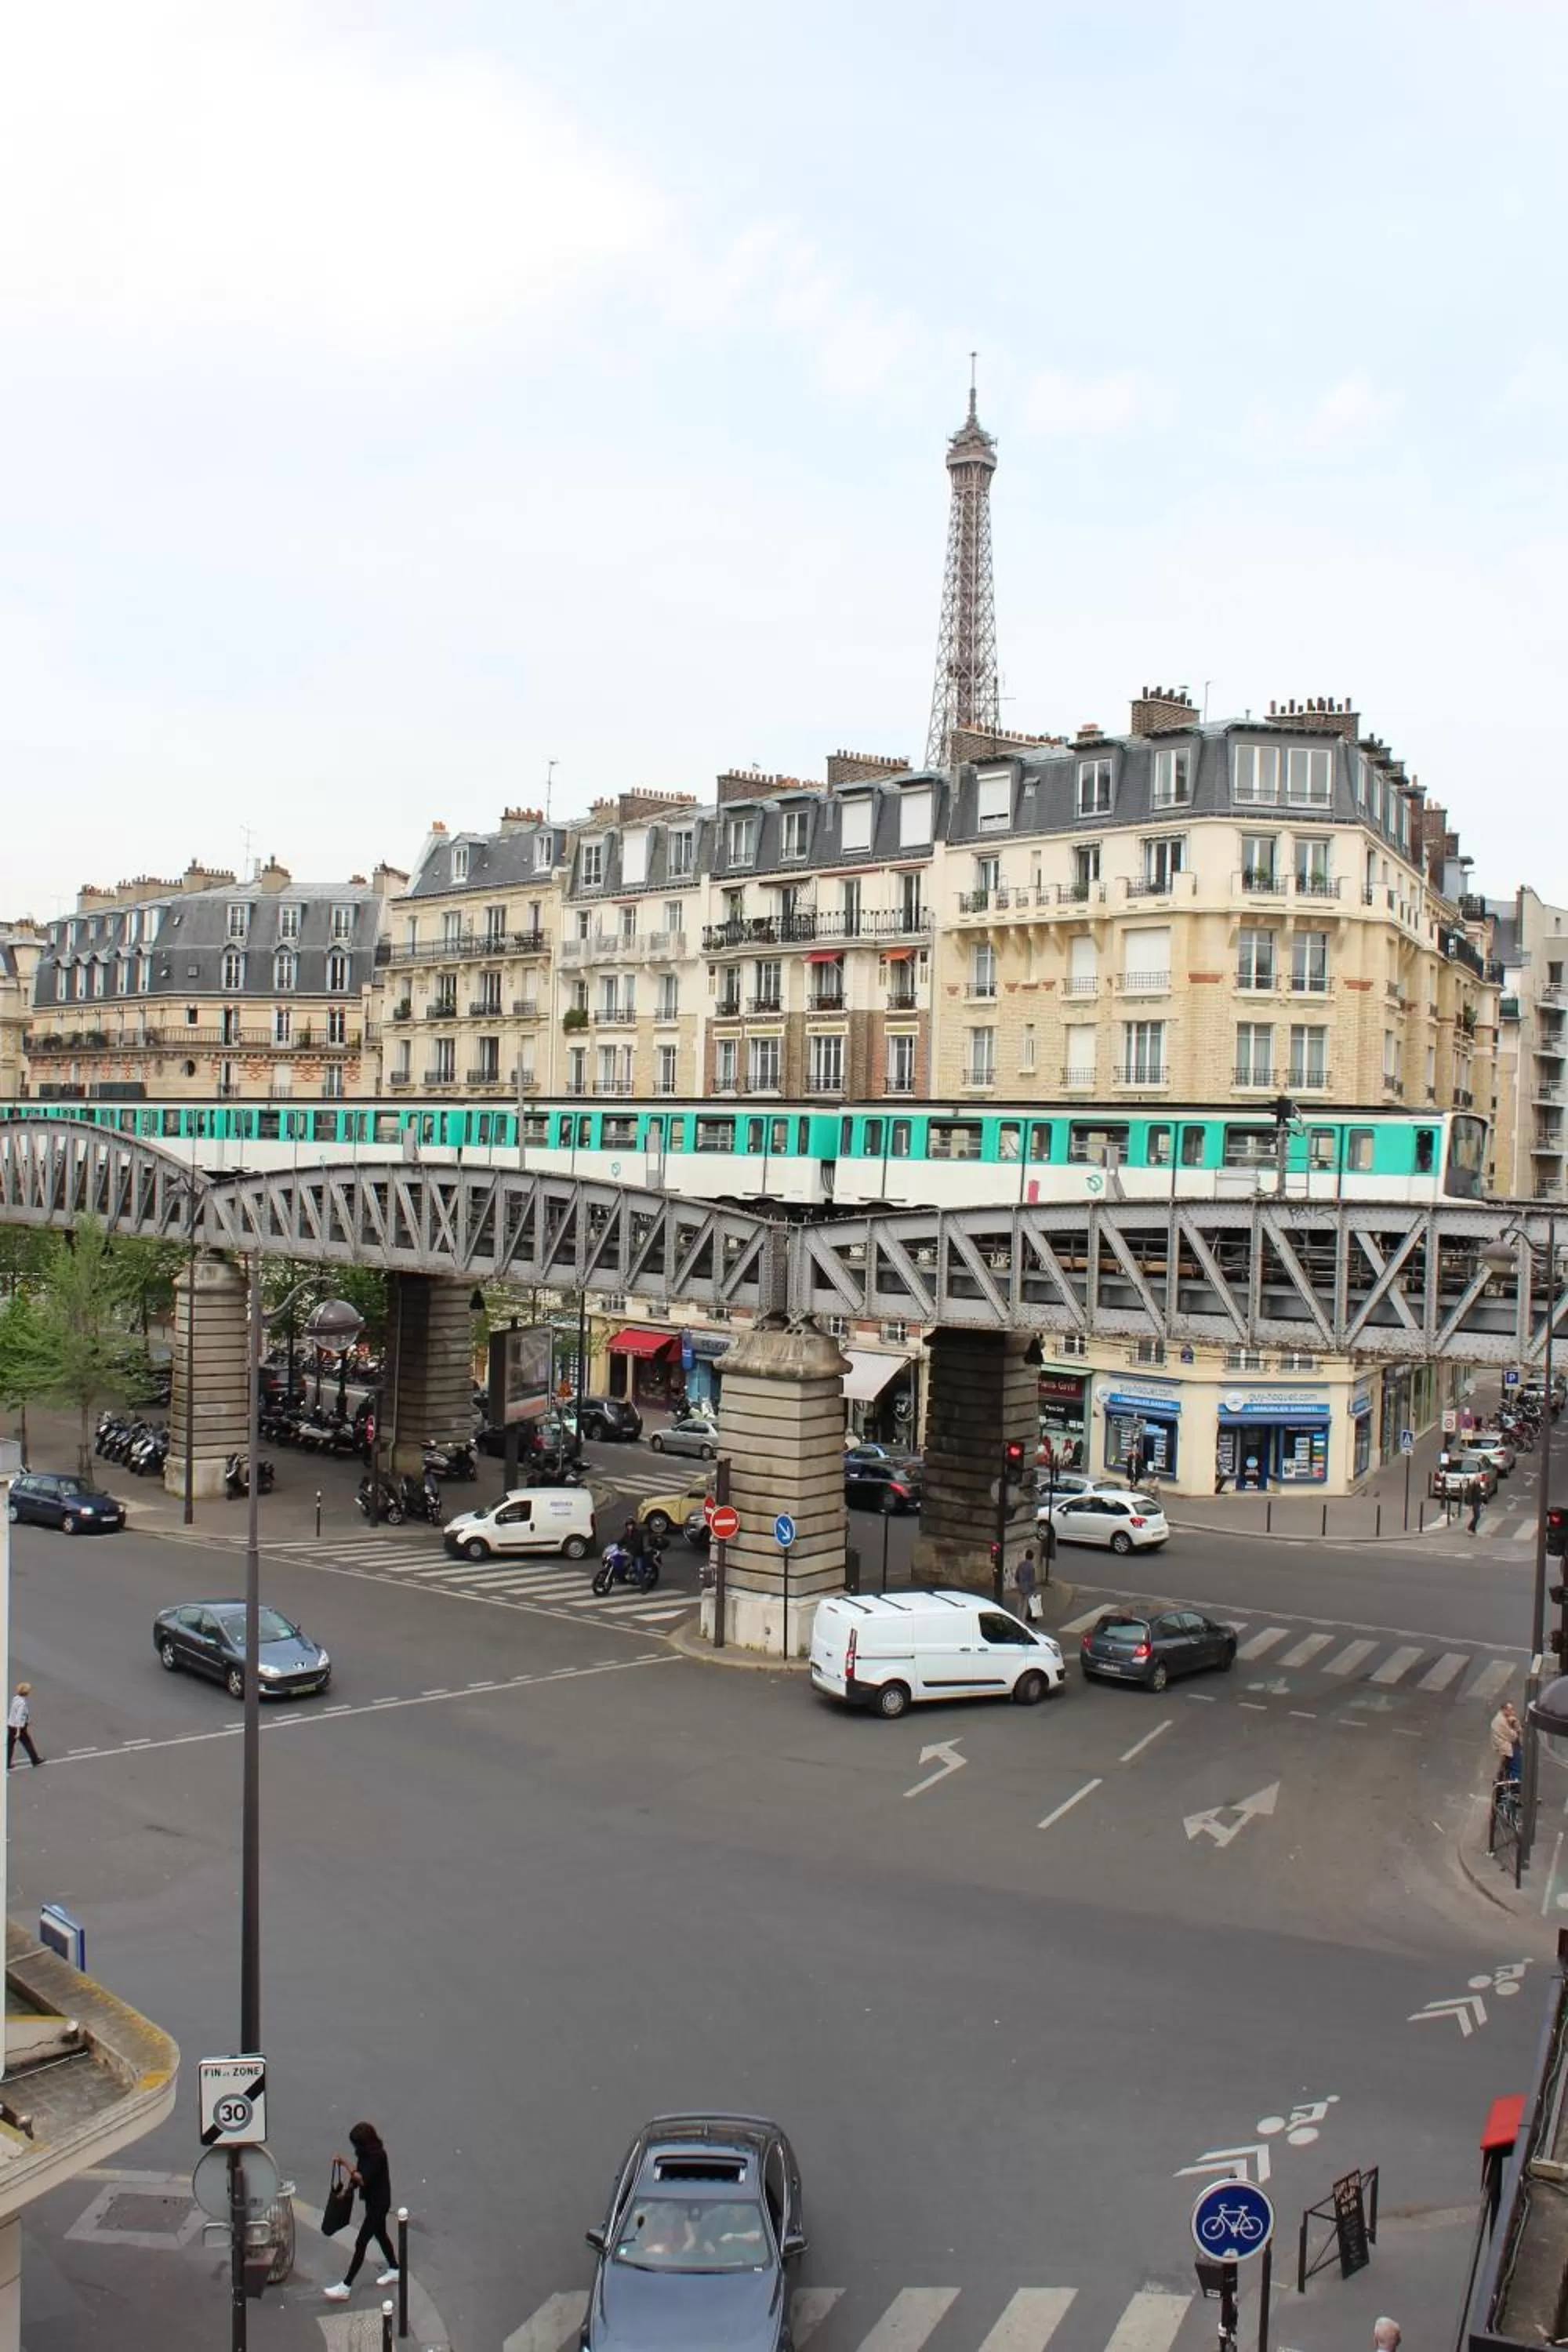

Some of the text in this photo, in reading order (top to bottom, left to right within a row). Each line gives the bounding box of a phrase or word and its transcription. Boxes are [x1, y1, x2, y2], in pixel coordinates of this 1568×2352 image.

[1508, 1373, 1515, 1384] P
[204, 2067, 221, 2078] FIN
[232, 2066, 260, 2077] ZONE
[222, 2103, 246, 2122] 30
